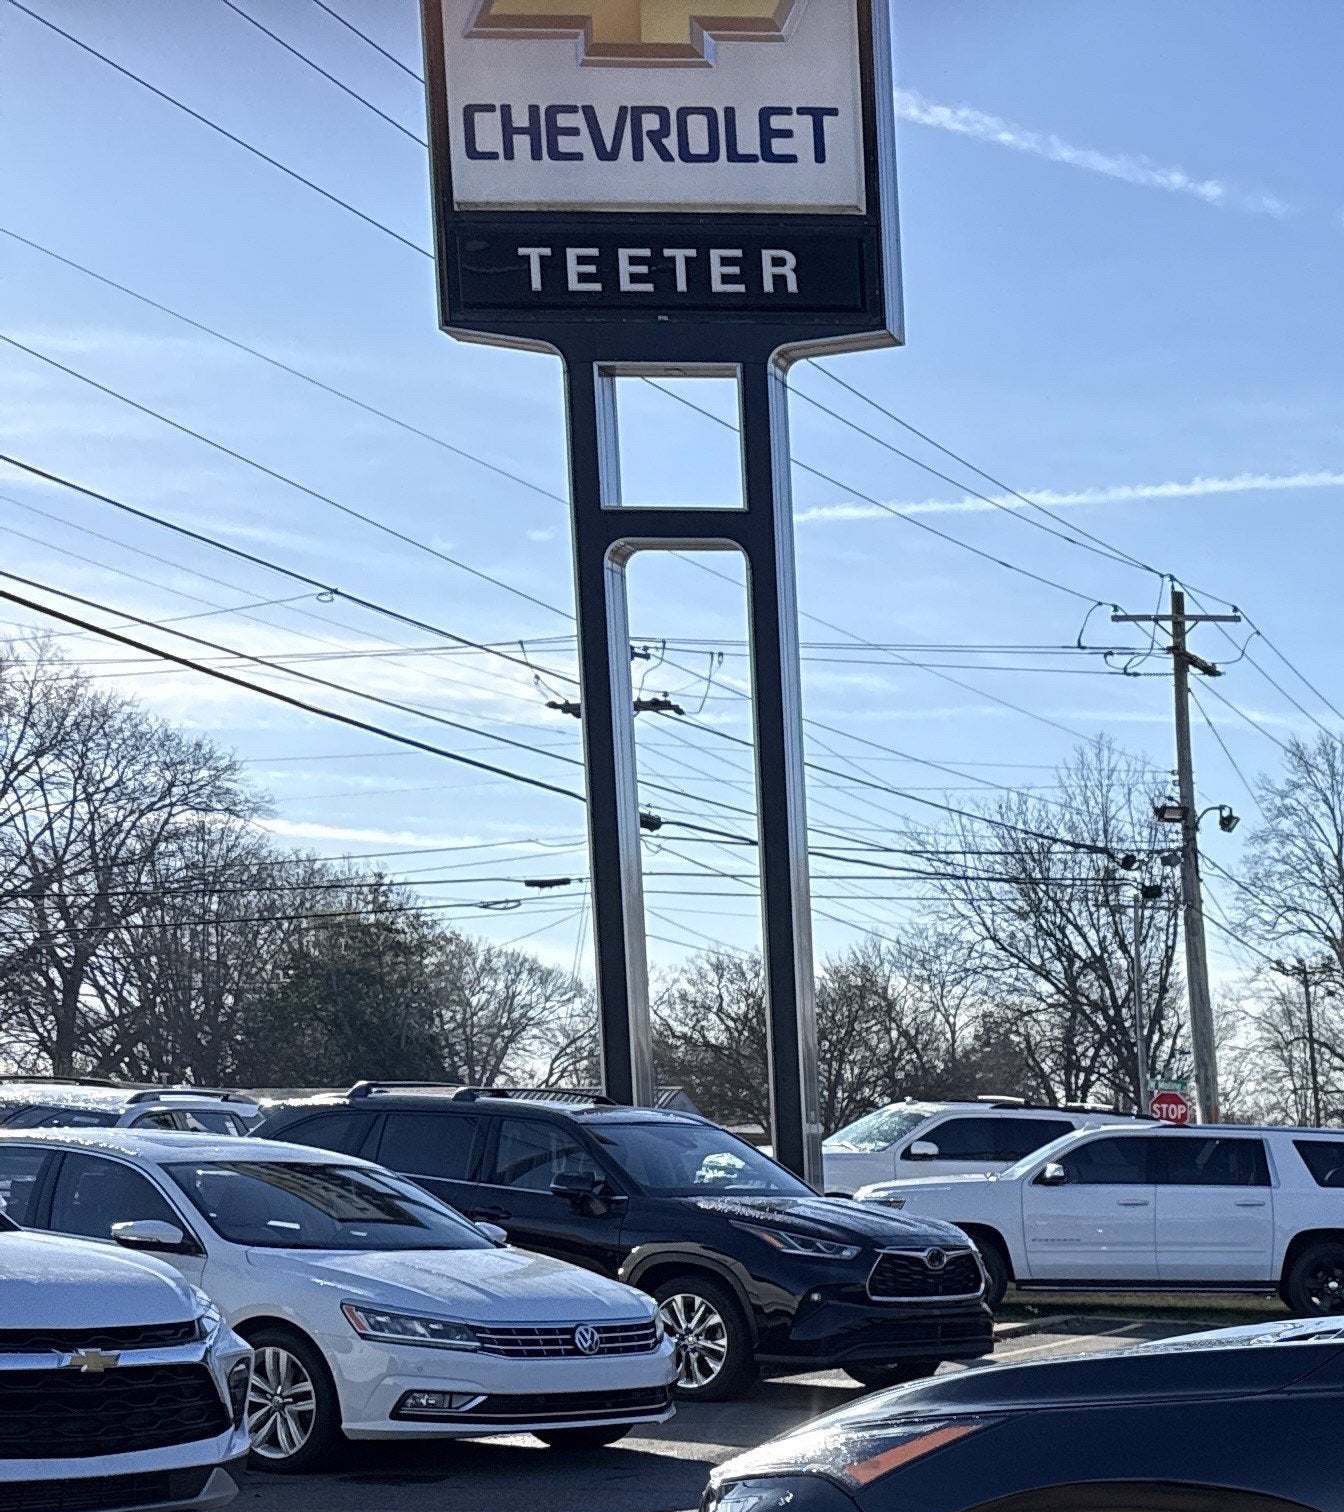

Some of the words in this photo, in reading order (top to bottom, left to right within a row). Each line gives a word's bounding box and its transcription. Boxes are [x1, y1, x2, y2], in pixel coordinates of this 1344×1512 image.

[462, 103, 839, 164] CHEVROLET
[517, 246, 799, 294] TEETER
[1152, 1103, 1187, 1119] STOP
